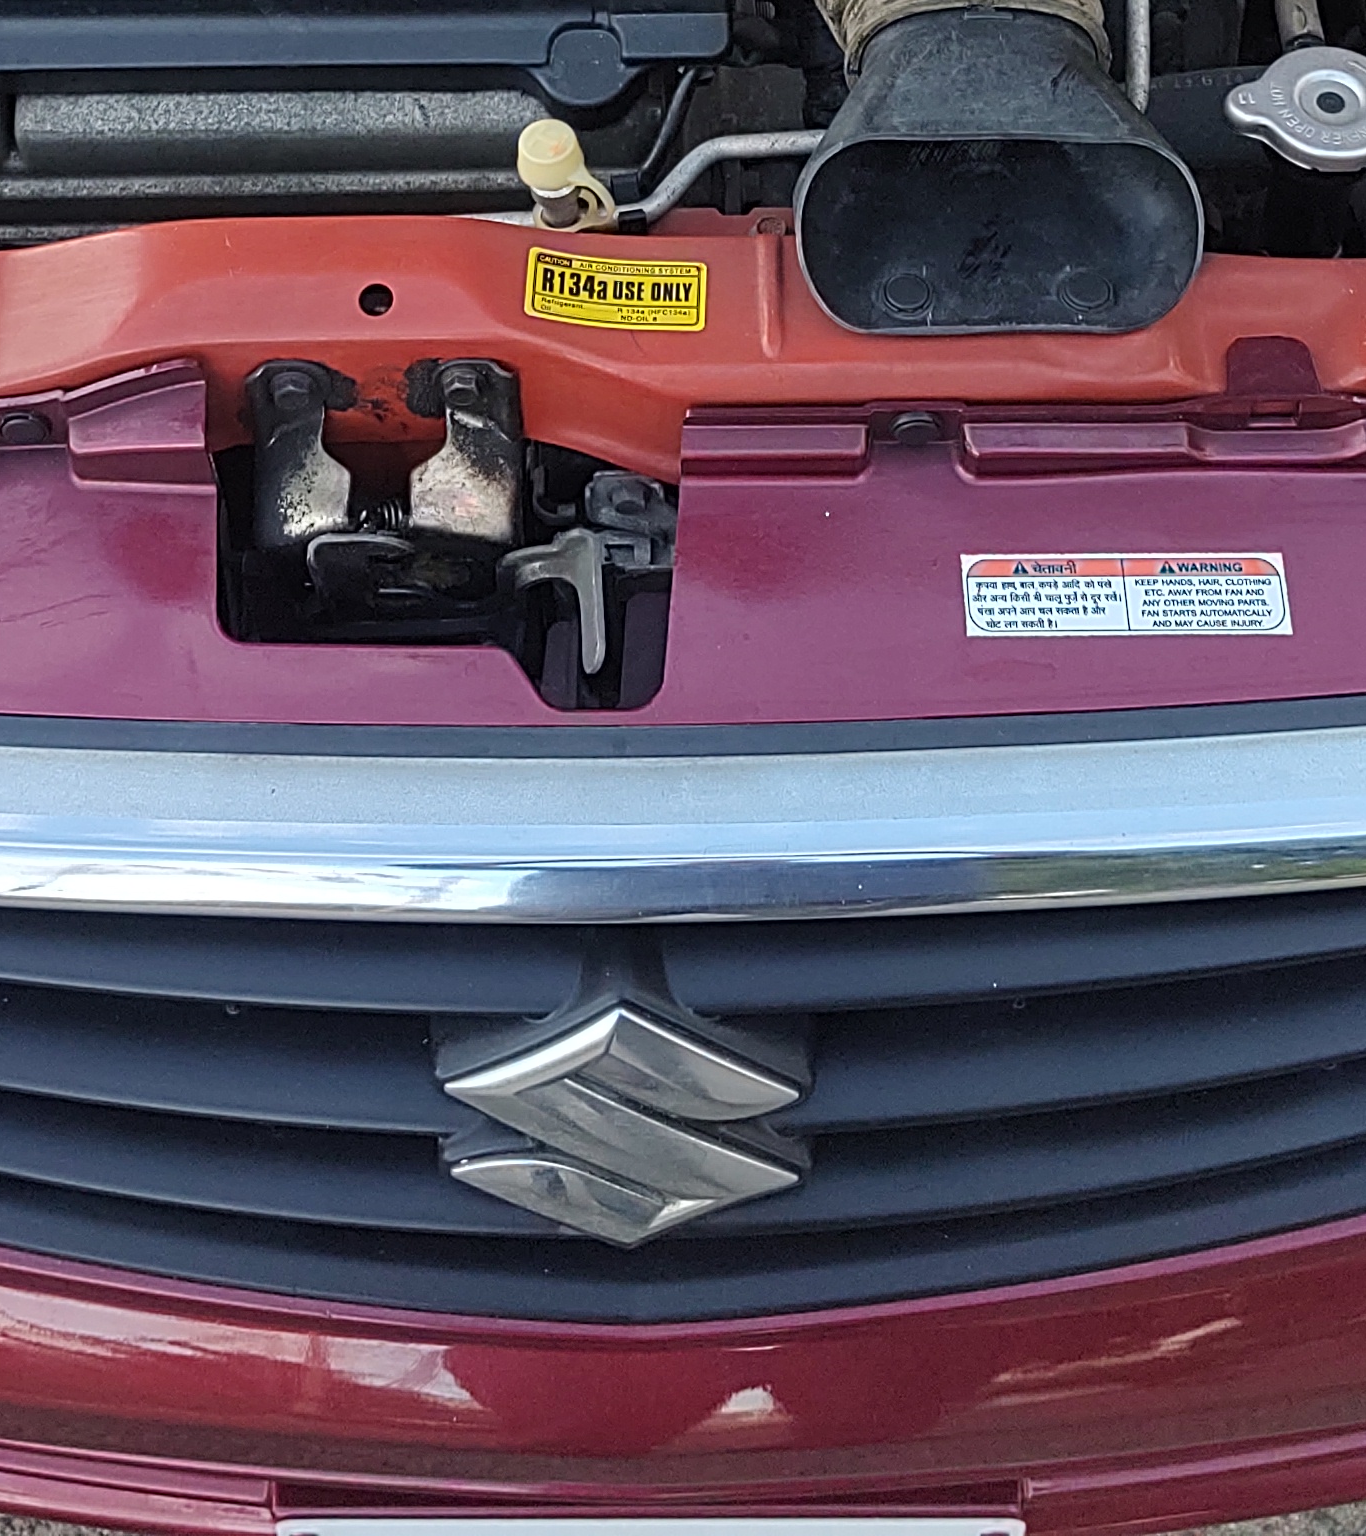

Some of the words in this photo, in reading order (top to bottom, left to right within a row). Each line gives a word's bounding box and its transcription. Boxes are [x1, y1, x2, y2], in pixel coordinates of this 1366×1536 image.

[1278, 109, 1316, 139] OPEN
[539, 254, 570, 267] CAUTION
[580, 262, 593, 270] AIR
[595, 264, 655, 274] CONDITIONING
[658, 267, 692, 275] SYSTEM
[542, 268, 607, 300] R134a
[613, 280, 645, 301] USE
[651, 282, 692, 302] ONLY
[1031, 561, 1076, 574] चेतावनी
[1177, 562, 1243, 572] WARNING
[1162, 579, 1195, 587] HANDS,
[1199, 579, 1222, 587] HAIR,
[1142, 599, 1161, 607] ANY
[1164, 599, 1195, 607] OTHER
[1200, 609, 1272, 617] AUTOMATICALLY
